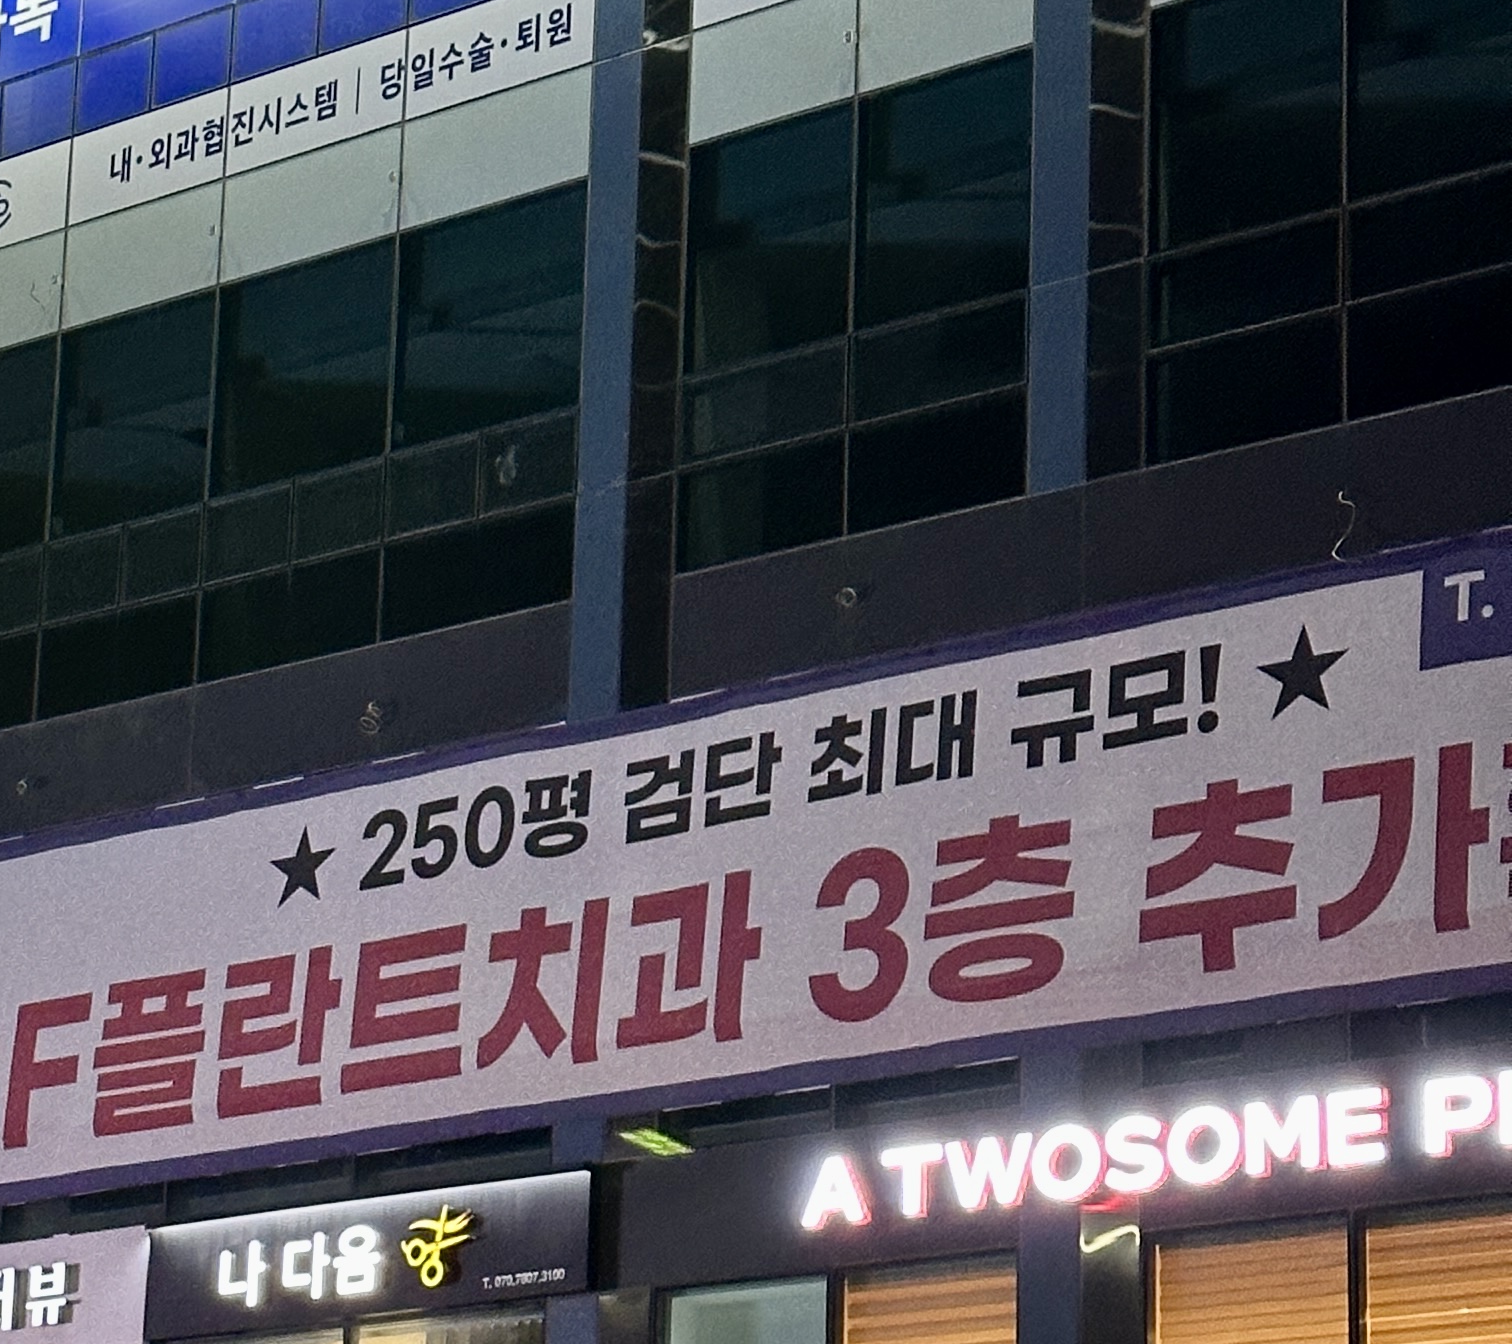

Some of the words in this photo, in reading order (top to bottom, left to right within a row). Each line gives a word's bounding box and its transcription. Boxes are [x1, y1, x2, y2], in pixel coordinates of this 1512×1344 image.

[360, 770, 594, 891] 250평
[623, 734, 786, 844] 검단
[807, 687, 980, 803] 최대
[1013, 644, 1223, 767] 규모!
[807, 817, 1074, 1023] 3층
[1138, 742, 1512, 974] 추가
[800, 1155, 871, 1230] A
[881, 1087, 1390, 1218] TWOSOME
[1421, 1068, 1512, 1158] P
